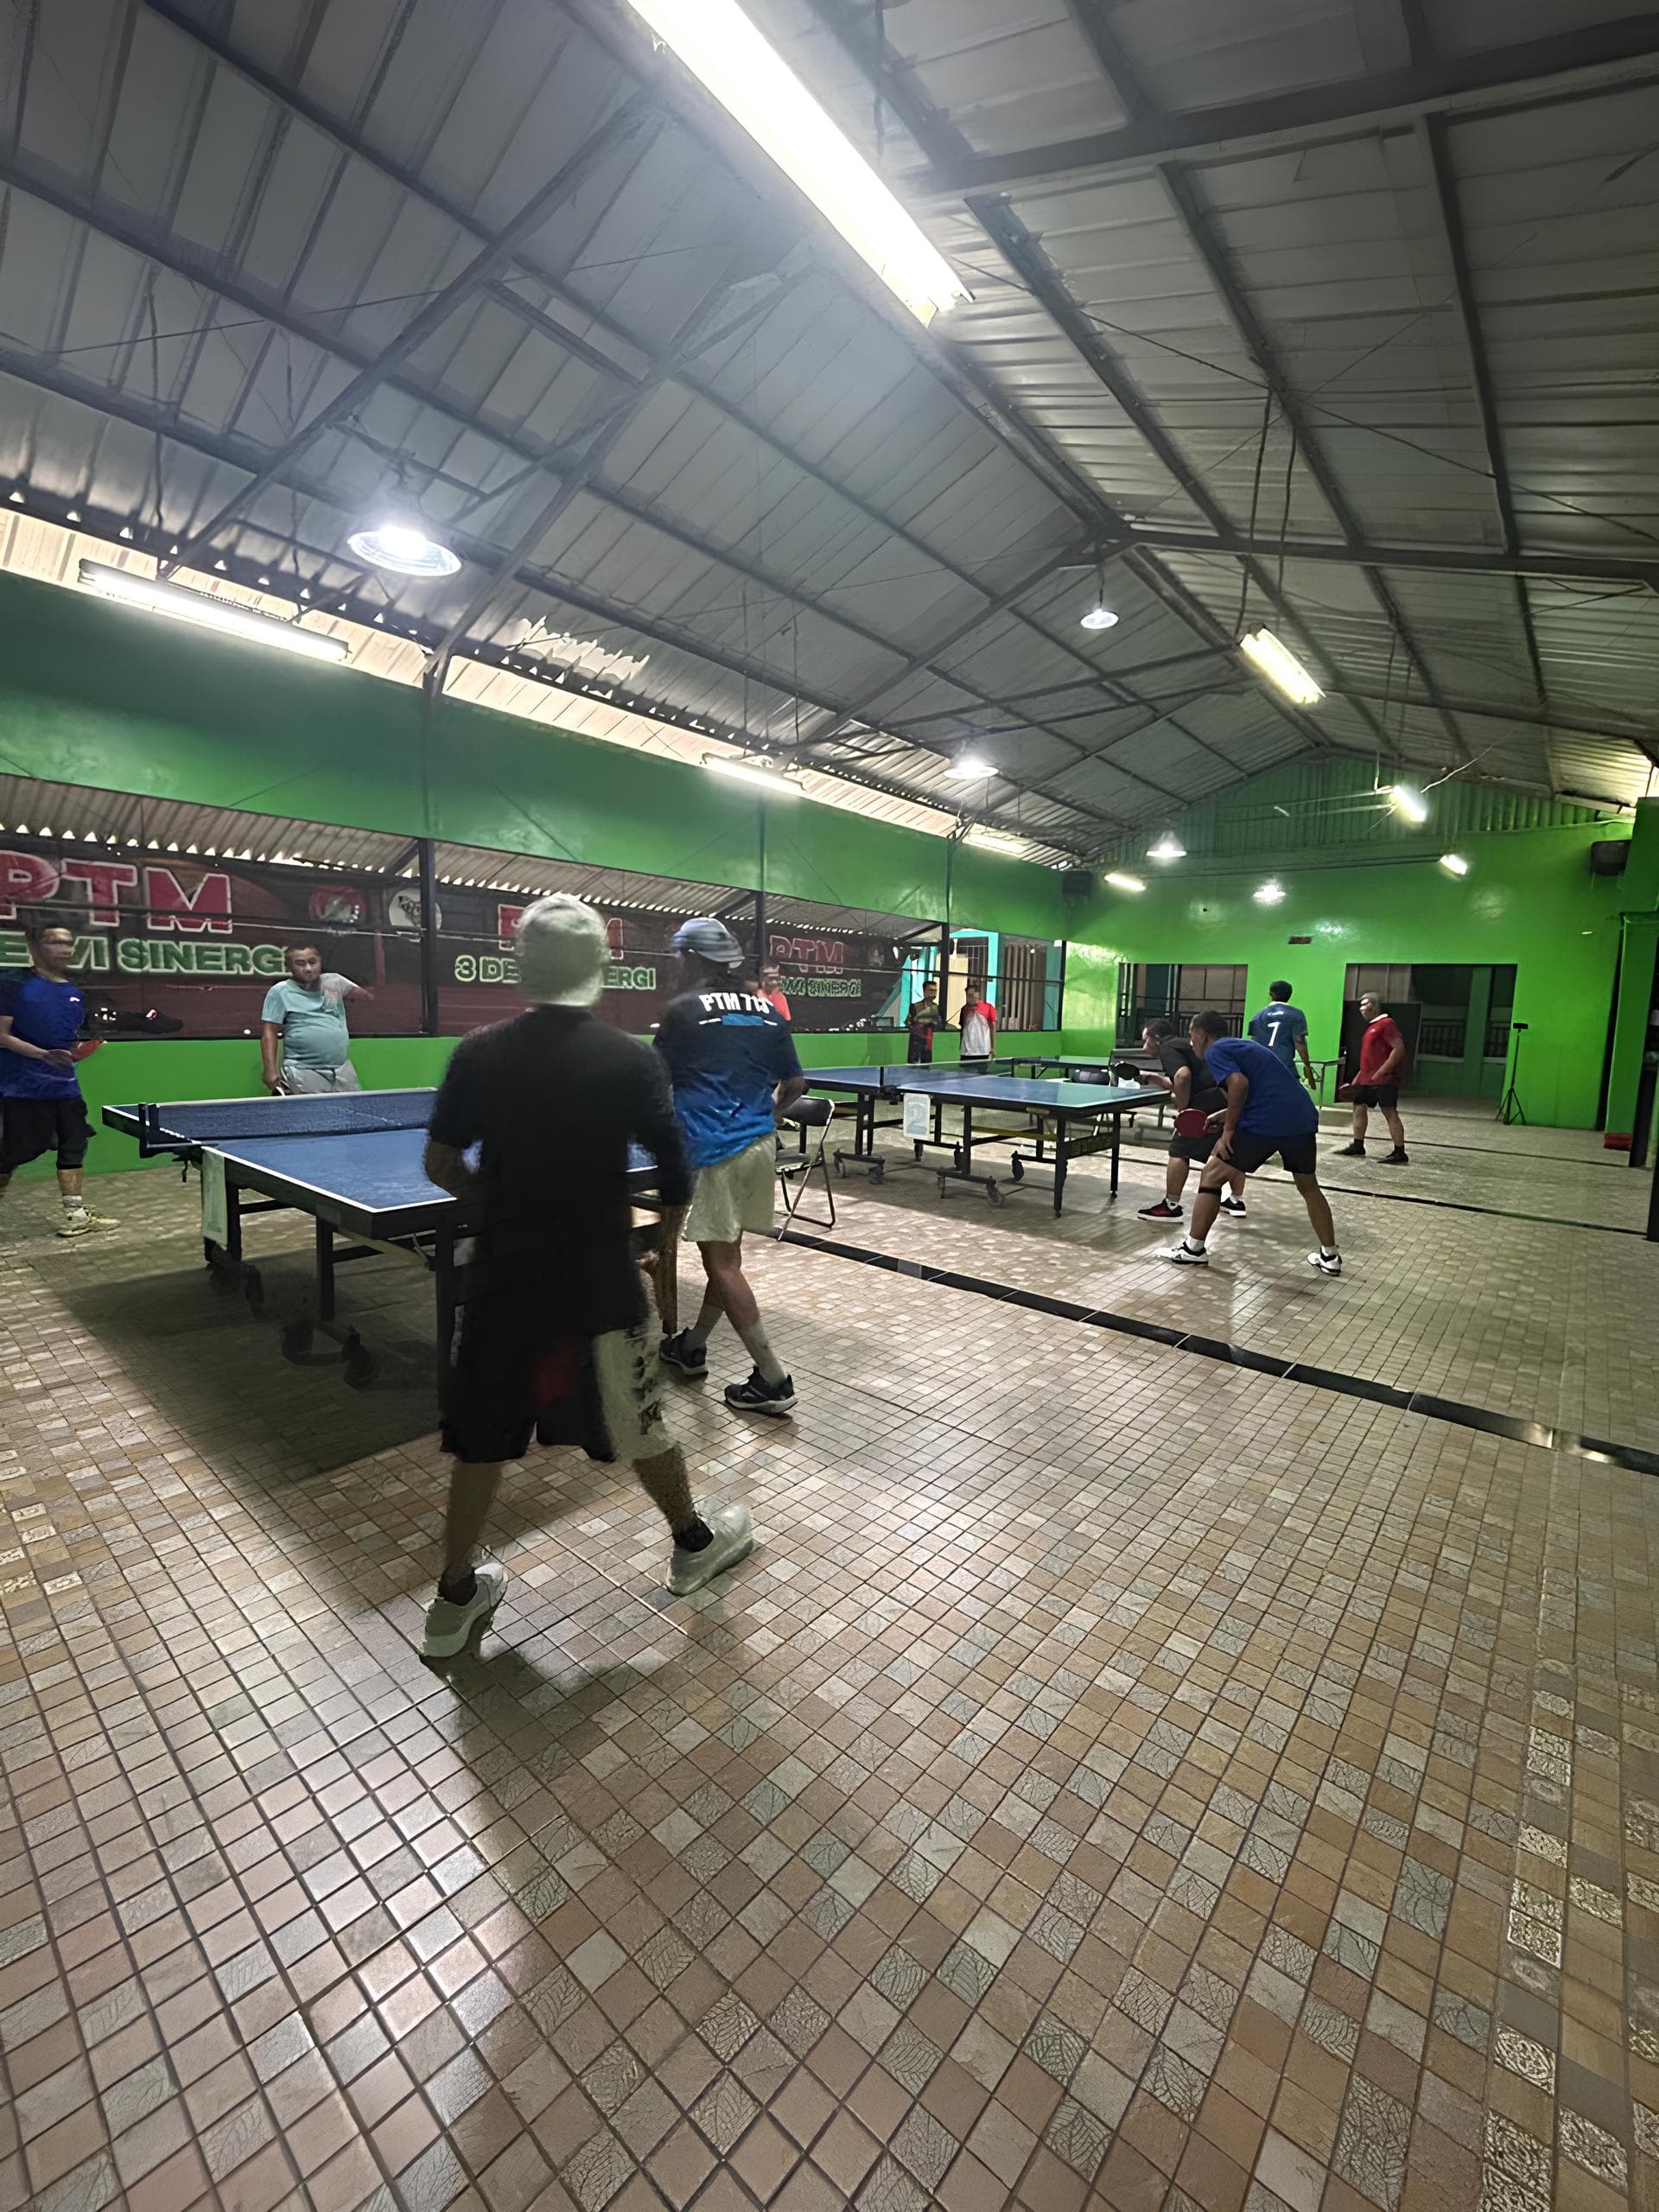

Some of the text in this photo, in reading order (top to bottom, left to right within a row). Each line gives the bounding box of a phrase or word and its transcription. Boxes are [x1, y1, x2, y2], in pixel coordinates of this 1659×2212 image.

[0, 849, 233, 934] PTM
[118, 938, 293, 977] SINERG
[601, 964, 657, 991] ERGI
[698, 992, 741, 1012] PTM
[1267, 1021, 1281, 1047] 7
